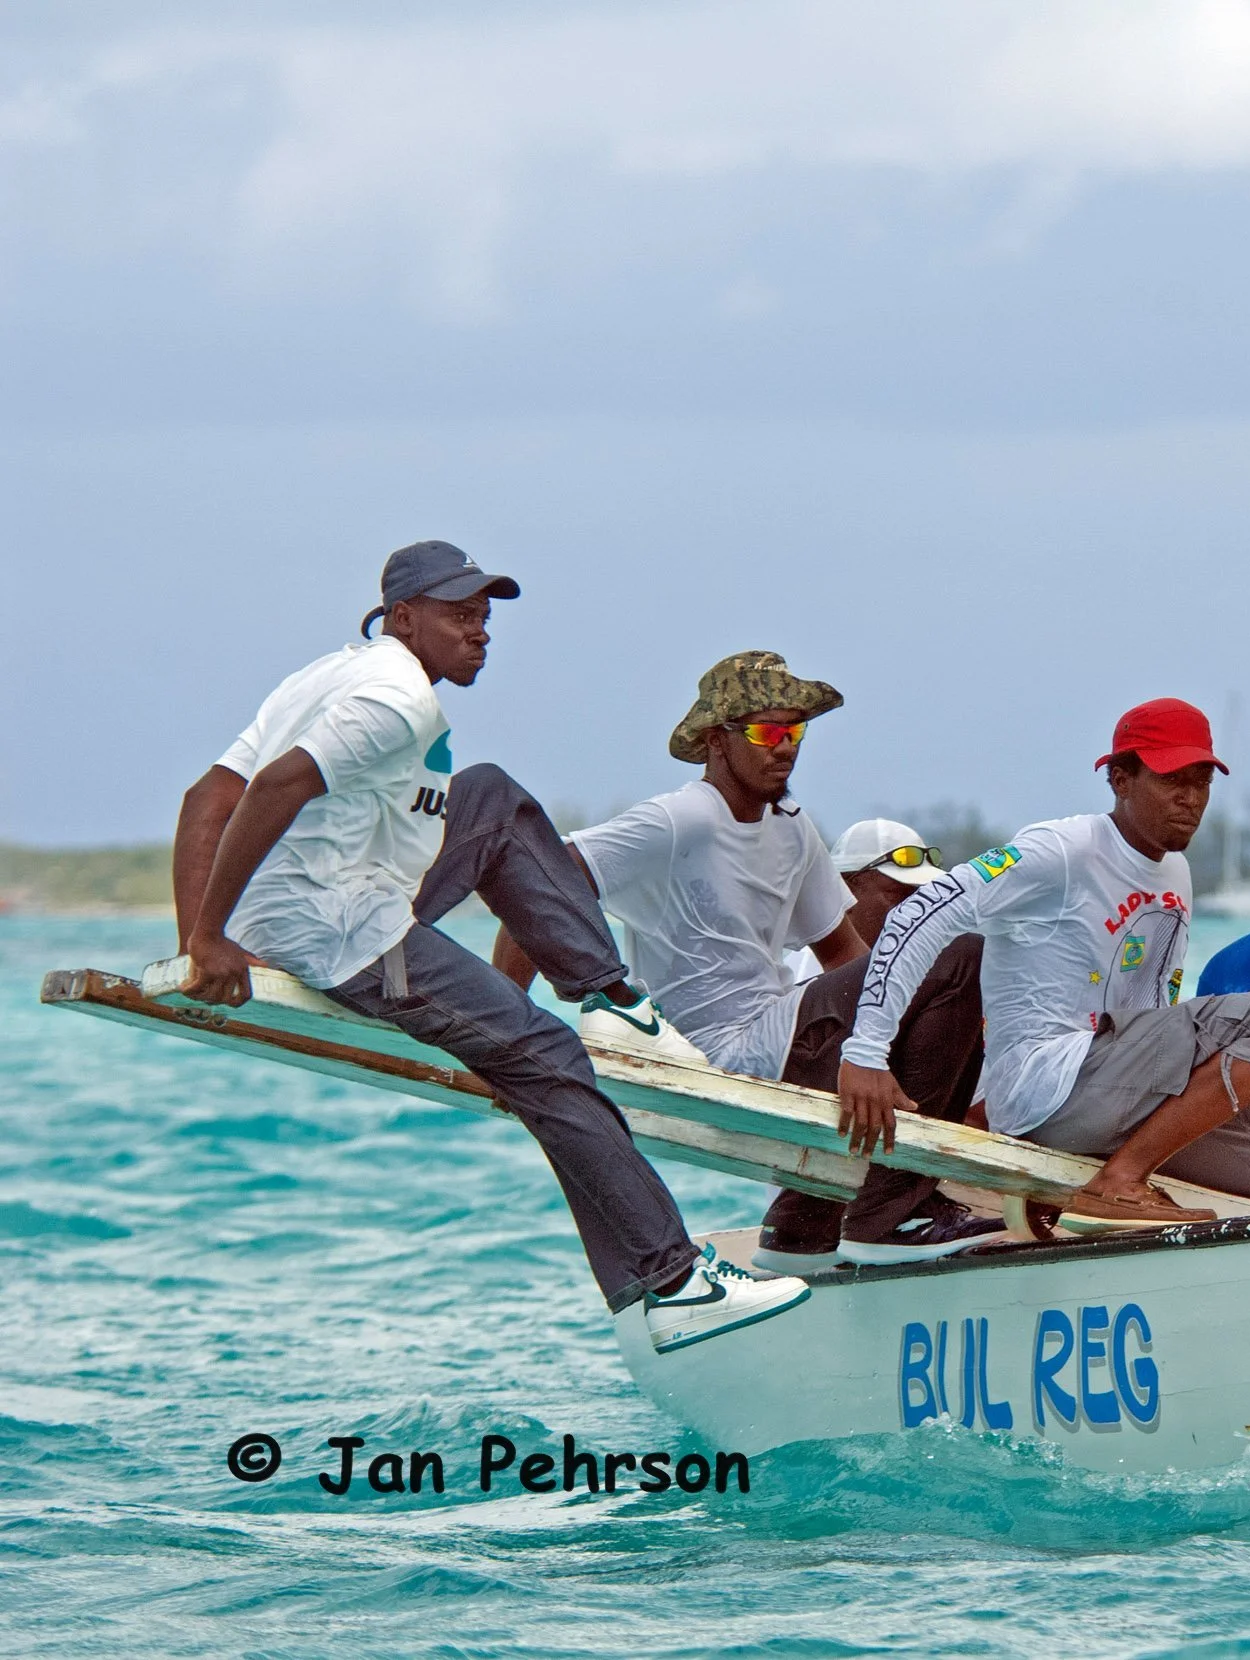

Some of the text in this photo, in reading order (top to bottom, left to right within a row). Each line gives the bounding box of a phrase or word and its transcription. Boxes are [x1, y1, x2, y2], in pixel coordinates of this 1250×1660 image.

[409, 786, 446, 820] JU
[863, 878, 961, 1001] VICTORY
[1104, 890, 1156, 936] LADY
[899, 1303, 1160, 1436] BUL REG
